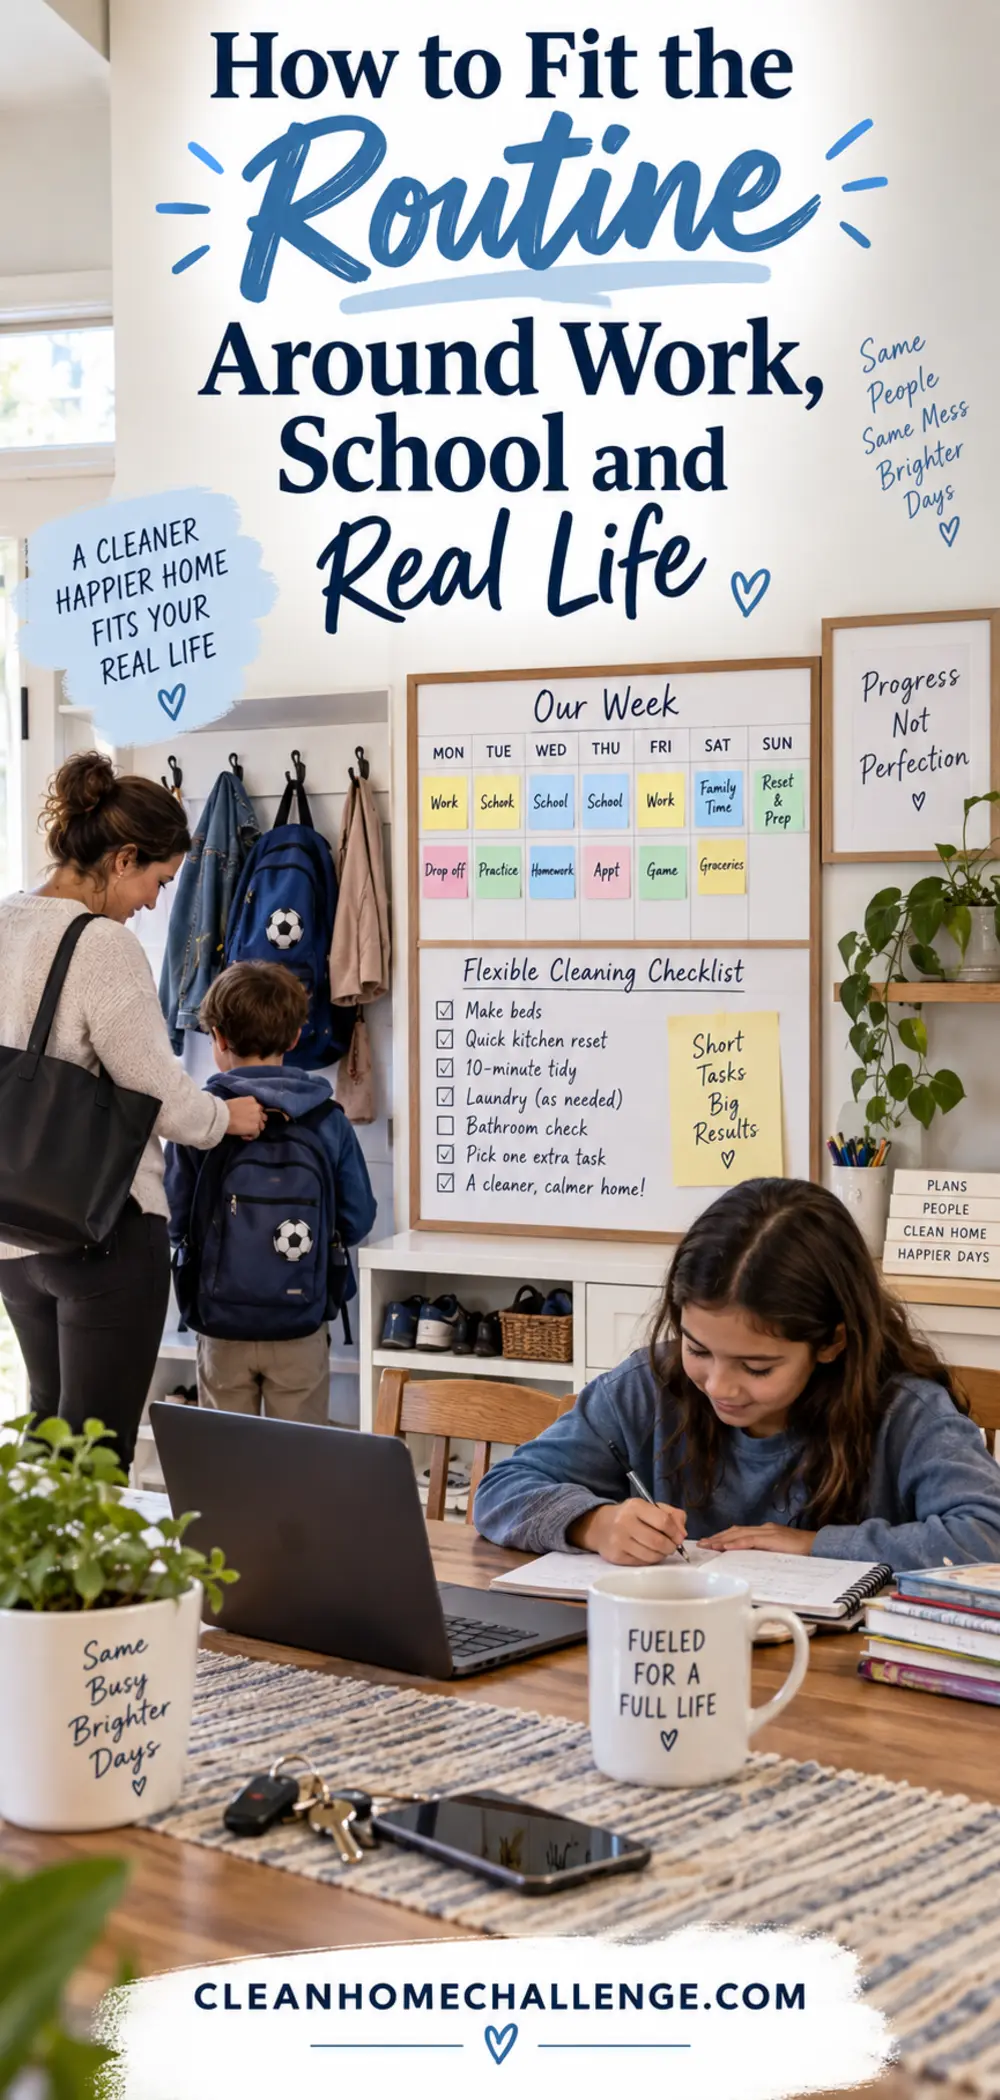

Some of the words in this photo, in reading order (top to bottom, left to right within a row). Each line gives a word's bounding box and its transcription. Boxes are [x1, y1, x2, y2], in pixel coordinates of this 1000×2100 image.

[862, 669, 960, 704] Progress
[534, 689, 587, 723] Our
[604, 683, 679, 721] Week
[893, 707, 930, 738] Not
[433, 747, 464, 760] MON
[486, 745, 512, 758] TUE
[536, 743, 567, 757] WED
[592, 742, 621, 755] THU
[650, 740, 672, 753] FRI
[705, 739, 731, 752] SAT
[763, 737, 792, 751] SUN
[860, 745, 969, 784] Perfection
[700, 779, 737, 800] Family
[763, 774, 793, 790] Reset
[431, 795, 458, 810] Work
[533, 794, 568, 809] School
[587, 793, 623, 809] School
[646, 793, 675, 808] Work
[705, 800, 732, 814] Time
[774, 795, 783, 808] &
[765, 812, 792, 829] Prep
[425, 863, 448, 880] Drop
[451, 862, 466, 878] off
[479, 863, 519, 877] Practice
[531, 863, 574, 876] Homework
[594, 863, 620, 881] Appt
[647, 863, 678, 877] Game
[700, 858, 744, 872] Groceries
[463, 958, 539, 983] Flexible
[550, 959, 636, 993] Cleaning
[648, 959, 744, 984] Checklist
[465, 1002, 503, 1019] Make
[510, 1003, 542, 1019] beds
[465, 1030, 505, 1048] Quick
[512, 1031, 564, 1048] kitchen
[571, 1033, 608, 1048] reset
[693, 1030, 744, 1060] Short
[466, 1058, 541, 1076] 10-minute
[548, 1059, 577, 1084] tidy
[696, 1059, 746, 1084] Tasks
[466, 1088, 527, 1113] Laundry
[535, 1088, 557, 1109] (as
[564, 1088, 623, 1110] needed)
[708, 1093, 739, 1120] Big
[466, 1117, 538, 1136] Bathroom
[546, 1117, 588, 1137] check
[694, 1119, 759, 1145] Results
[466, 1146, 497, 1164] Pick
[503, 1152, 527, 1164] one
[533, 1150, 569, 1165] extra
[576, 1148, 606, 1166] task
[465, 1174, 476, 1192] A
[483, 1175, 538, 1196] cleaner,
[545, 1176, 595, 1195] calmer
[600, 1176, 645, 1197] home!
[928, 1180, 967, 1192] PLANS
[923, 1203, 969, 1215] PEOPLE
[904, 1225, 944, 1237] CLEAN
[950, 1227, 987, 1239] HOME
[898, 1248, 950, 1261] HAPPIER
[957, 1251, 990, 1263] DAYS
[629, 1629, 705, 1653] FUELED
[83, 1639, 148, 1670] Same
[635, 1663, 675, 1686] FOR
[687, 1662, 700, 1684] A
[85, 1674, 148, 1706] Busy
[620, 1694, 667, 1718] FULL
[678, 1693, 716, 1719] LIFE
[68, 1699, 171, 1747] Brighter
[89, 1741, 161, 1779] Days
